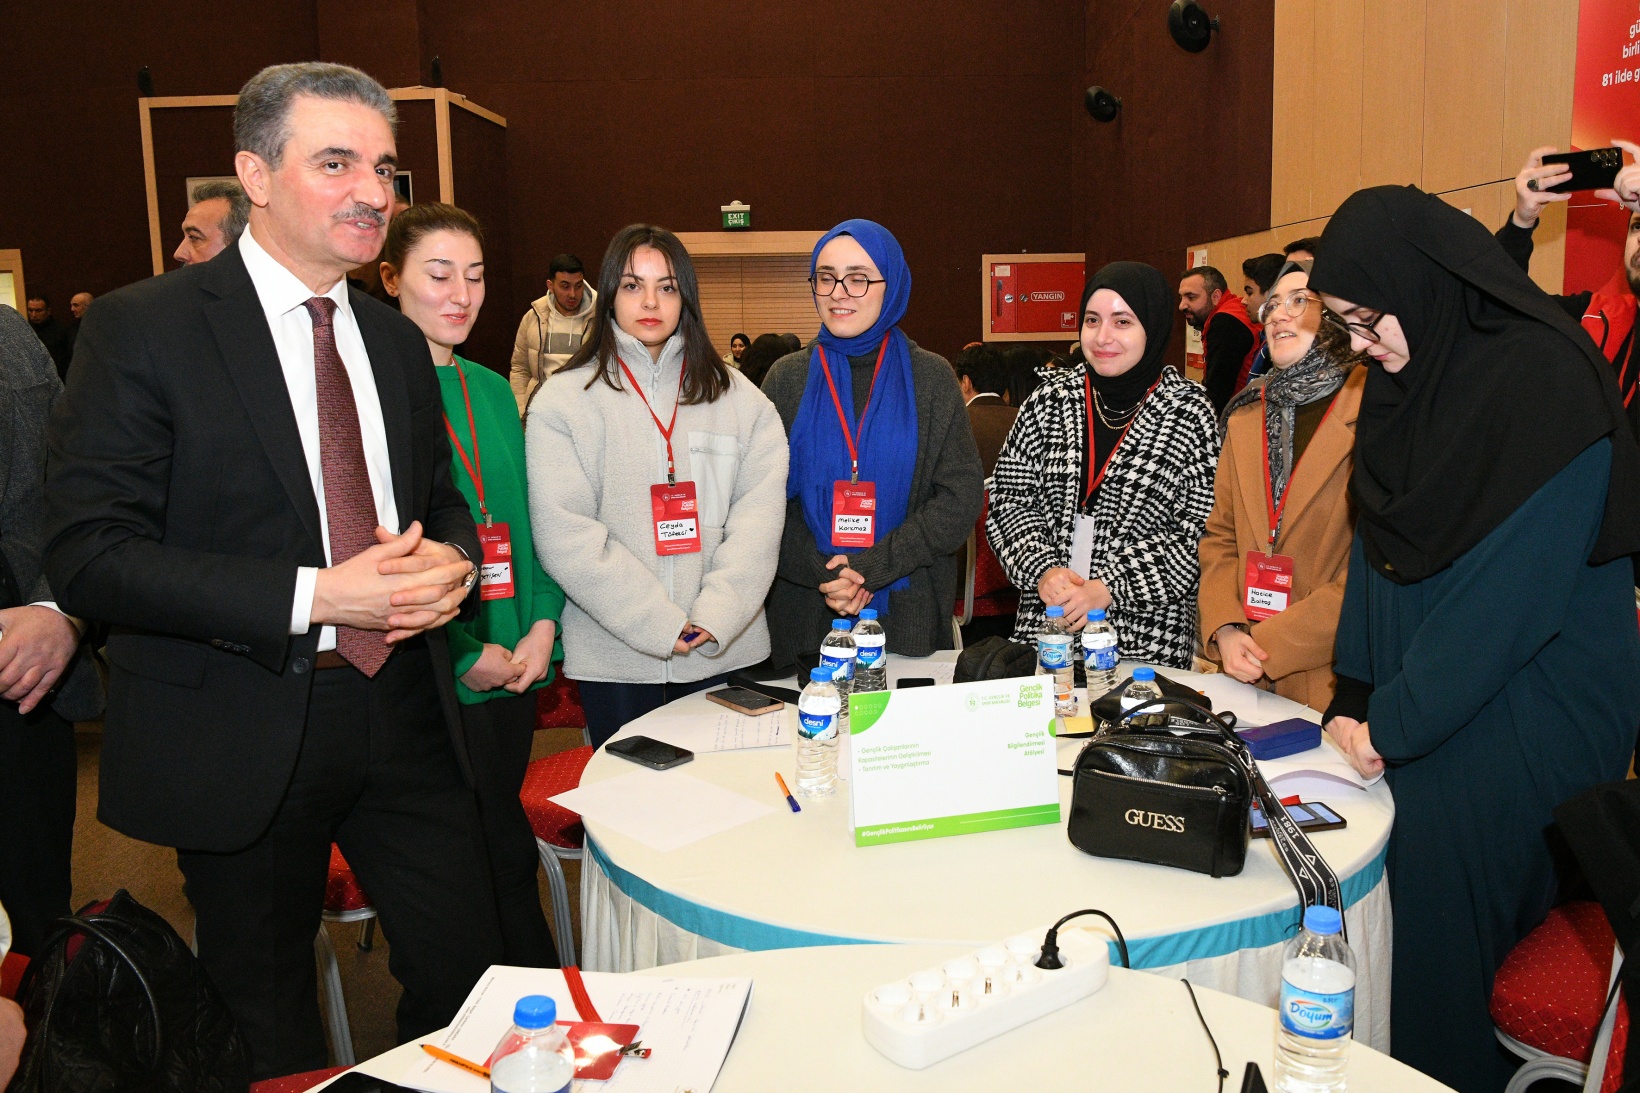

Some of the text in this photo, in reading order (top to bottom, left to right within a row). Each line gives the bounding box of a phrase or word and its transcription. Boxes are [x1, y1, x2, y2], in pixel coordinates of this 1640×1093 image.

[1601, 72, 1613, 87] 81
[1614, 68, 1633, 85] ilde
[1033, 292, 1063, 300] YANGIN
[659, 522, 684, 530] Ceyda
[859, 649, 878, 657] desni
[1042, 650, 1063, 660] Doyum
[821, 658, 839, 667] desni
[1019, 683, 1043, 693] Gençlik
[1019, 692, 1043, 700] Politika
[1017, 699, 1041, 708] Belgesi
[803, 717, 825, 727] desni
[1007, 740, 1046, 749] Bilgilendirmesi
[861, 746, 882, 755] Gençlik
[1124, 808, 1185, 833] GUESS
[1280, 815, 1300, 839] 1981
[1290, 1001, 1333, 1024] Doyum
